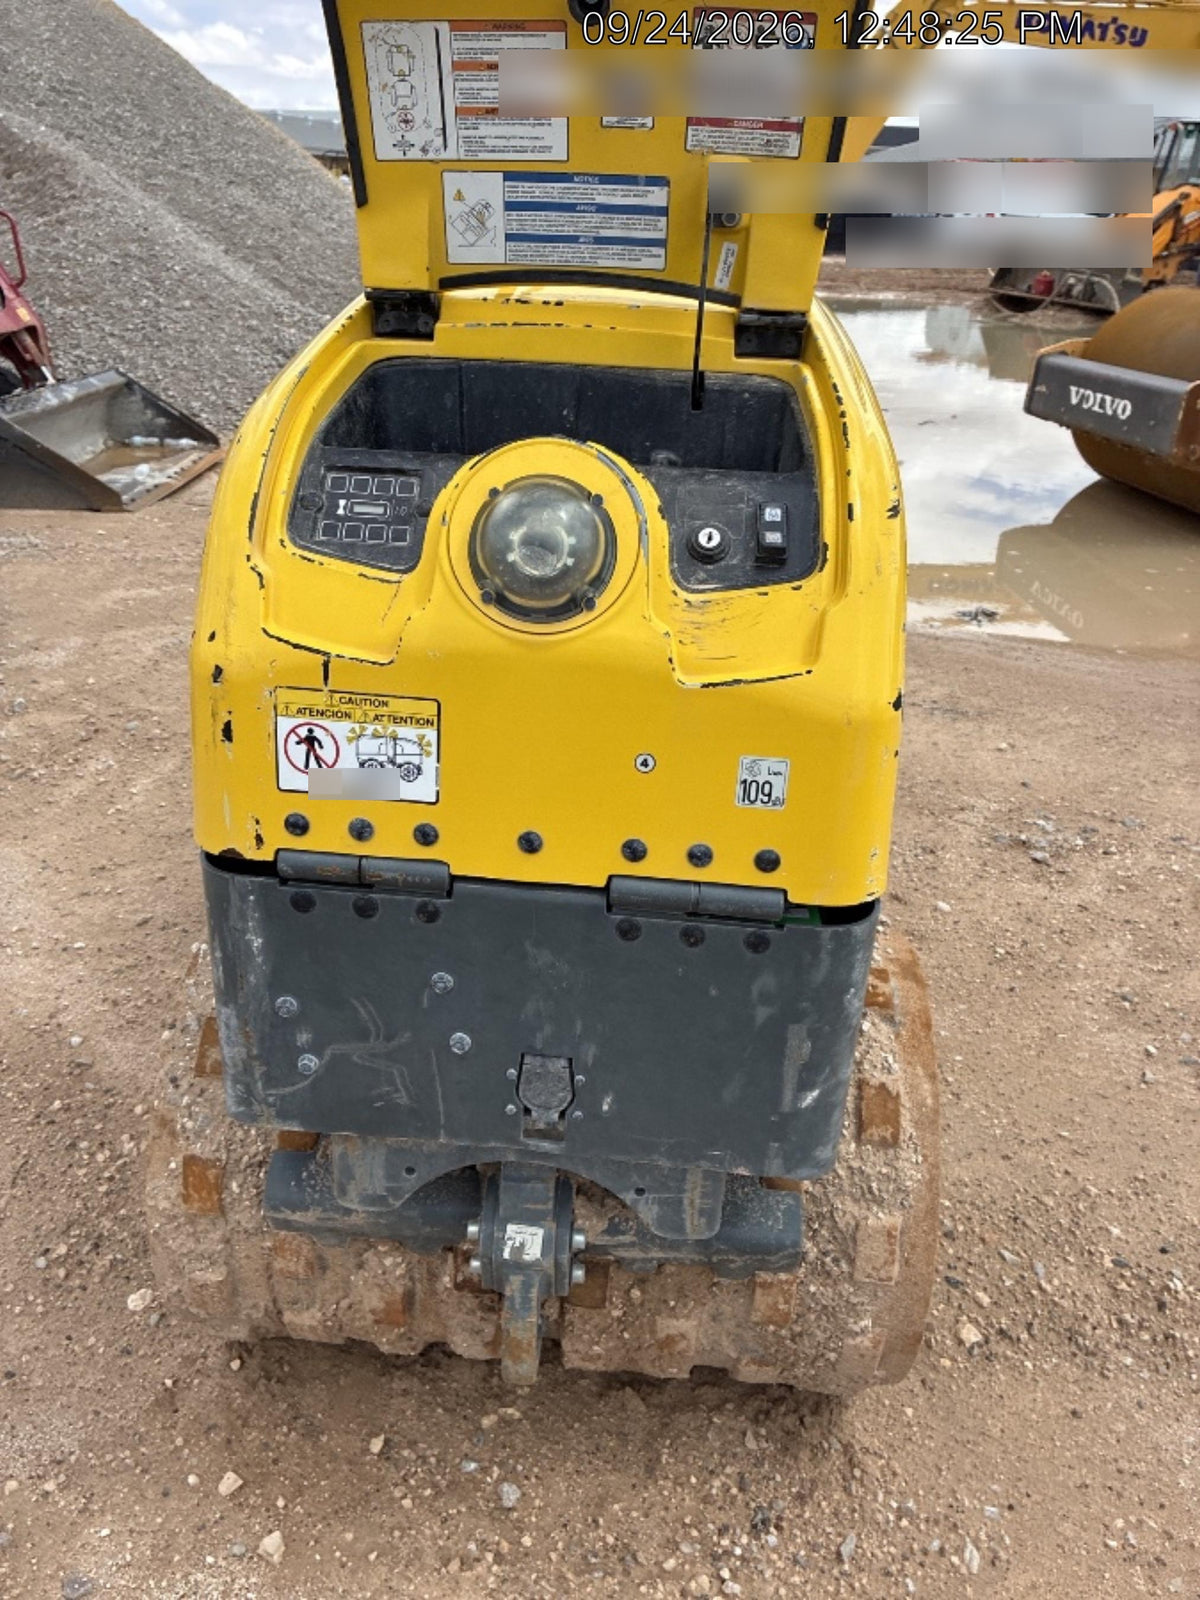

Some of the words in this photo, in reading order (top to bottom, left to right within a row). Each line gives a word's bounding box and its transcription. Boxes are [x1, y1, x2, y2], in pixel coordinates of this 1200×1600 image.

[1069, 385, 1132, 420] VOLVO
[338, 696, 389, 708] CAUTION
[373, 714, 434, 727] ATTENTION
[640, 758, 649, 768] 4
[740, 779, 773, 804] 109
